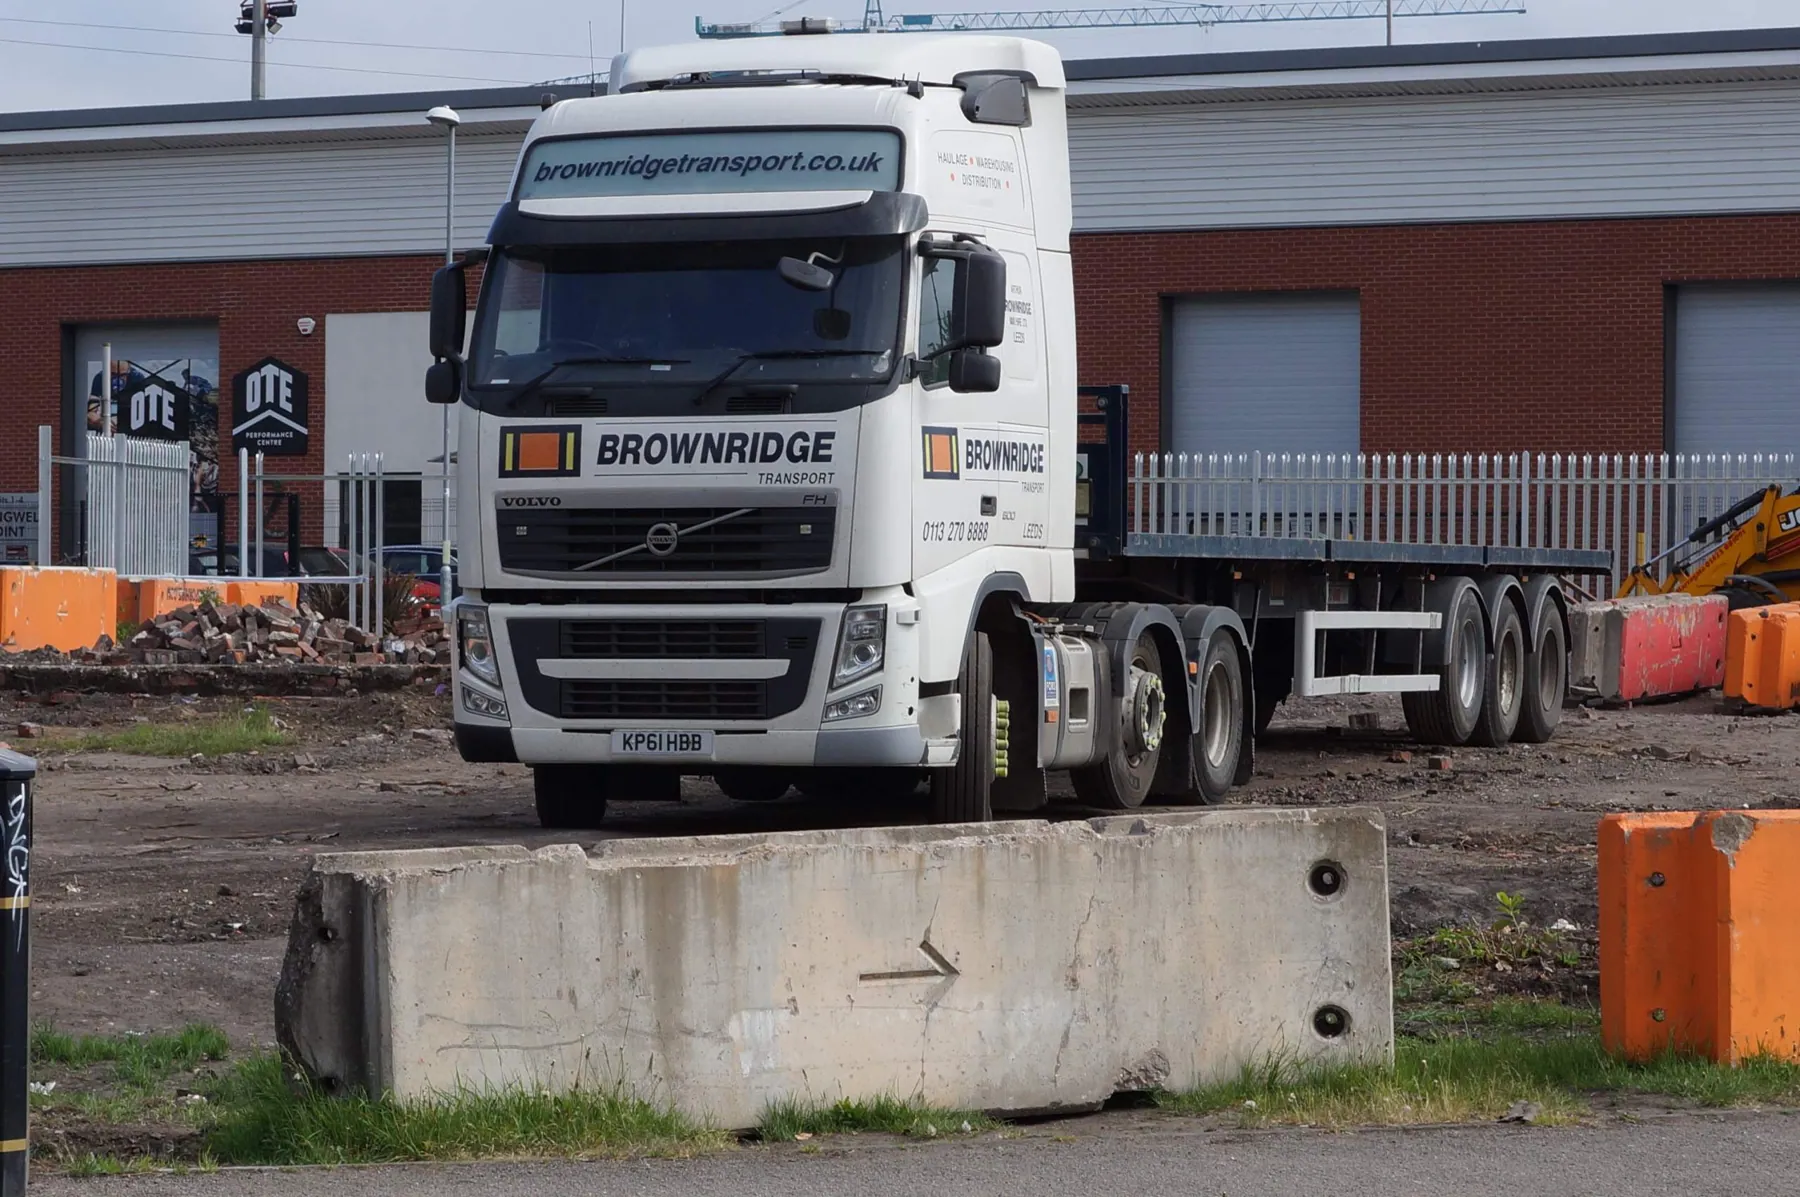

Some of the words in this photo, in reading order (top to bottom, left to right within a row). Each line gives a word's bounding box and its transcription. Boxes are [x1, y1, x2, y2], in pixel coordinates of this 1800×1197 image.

[534, 151, 884, 182] brownridgetransport.co.uk
[938, 152, 968, 166] HAULAGE
[976, 157, 1014, 173] WAREHOUSING
[962, 173, 1002, 190] DISTRIBUTION
[1005, 300, 1032, 315] ROWNRIDGE
[246, 363, 293, 413] OTE
[130, 384, 175, 431] OTE
[597, 431, 836, 466] BROWNRIDGE
[965, 439, 1044, 473] BROWNRIDGE
[758, 472, 836, 486] TRANSPORT
[1021, 481, 1045, 494] TRANSPORT
[501, 496, 562, 507] VOLVO
[802, 494, 828, 505] FH
[922, 521, 945, 541] 0113
[947, 521, 965, 541] 270
[967, 521, 989, 541] 8888
[1022, 523, 1043, 540] LEEDS
[623, 733, 662, 751] KP61
[666, 733, 702, 751] HBB
